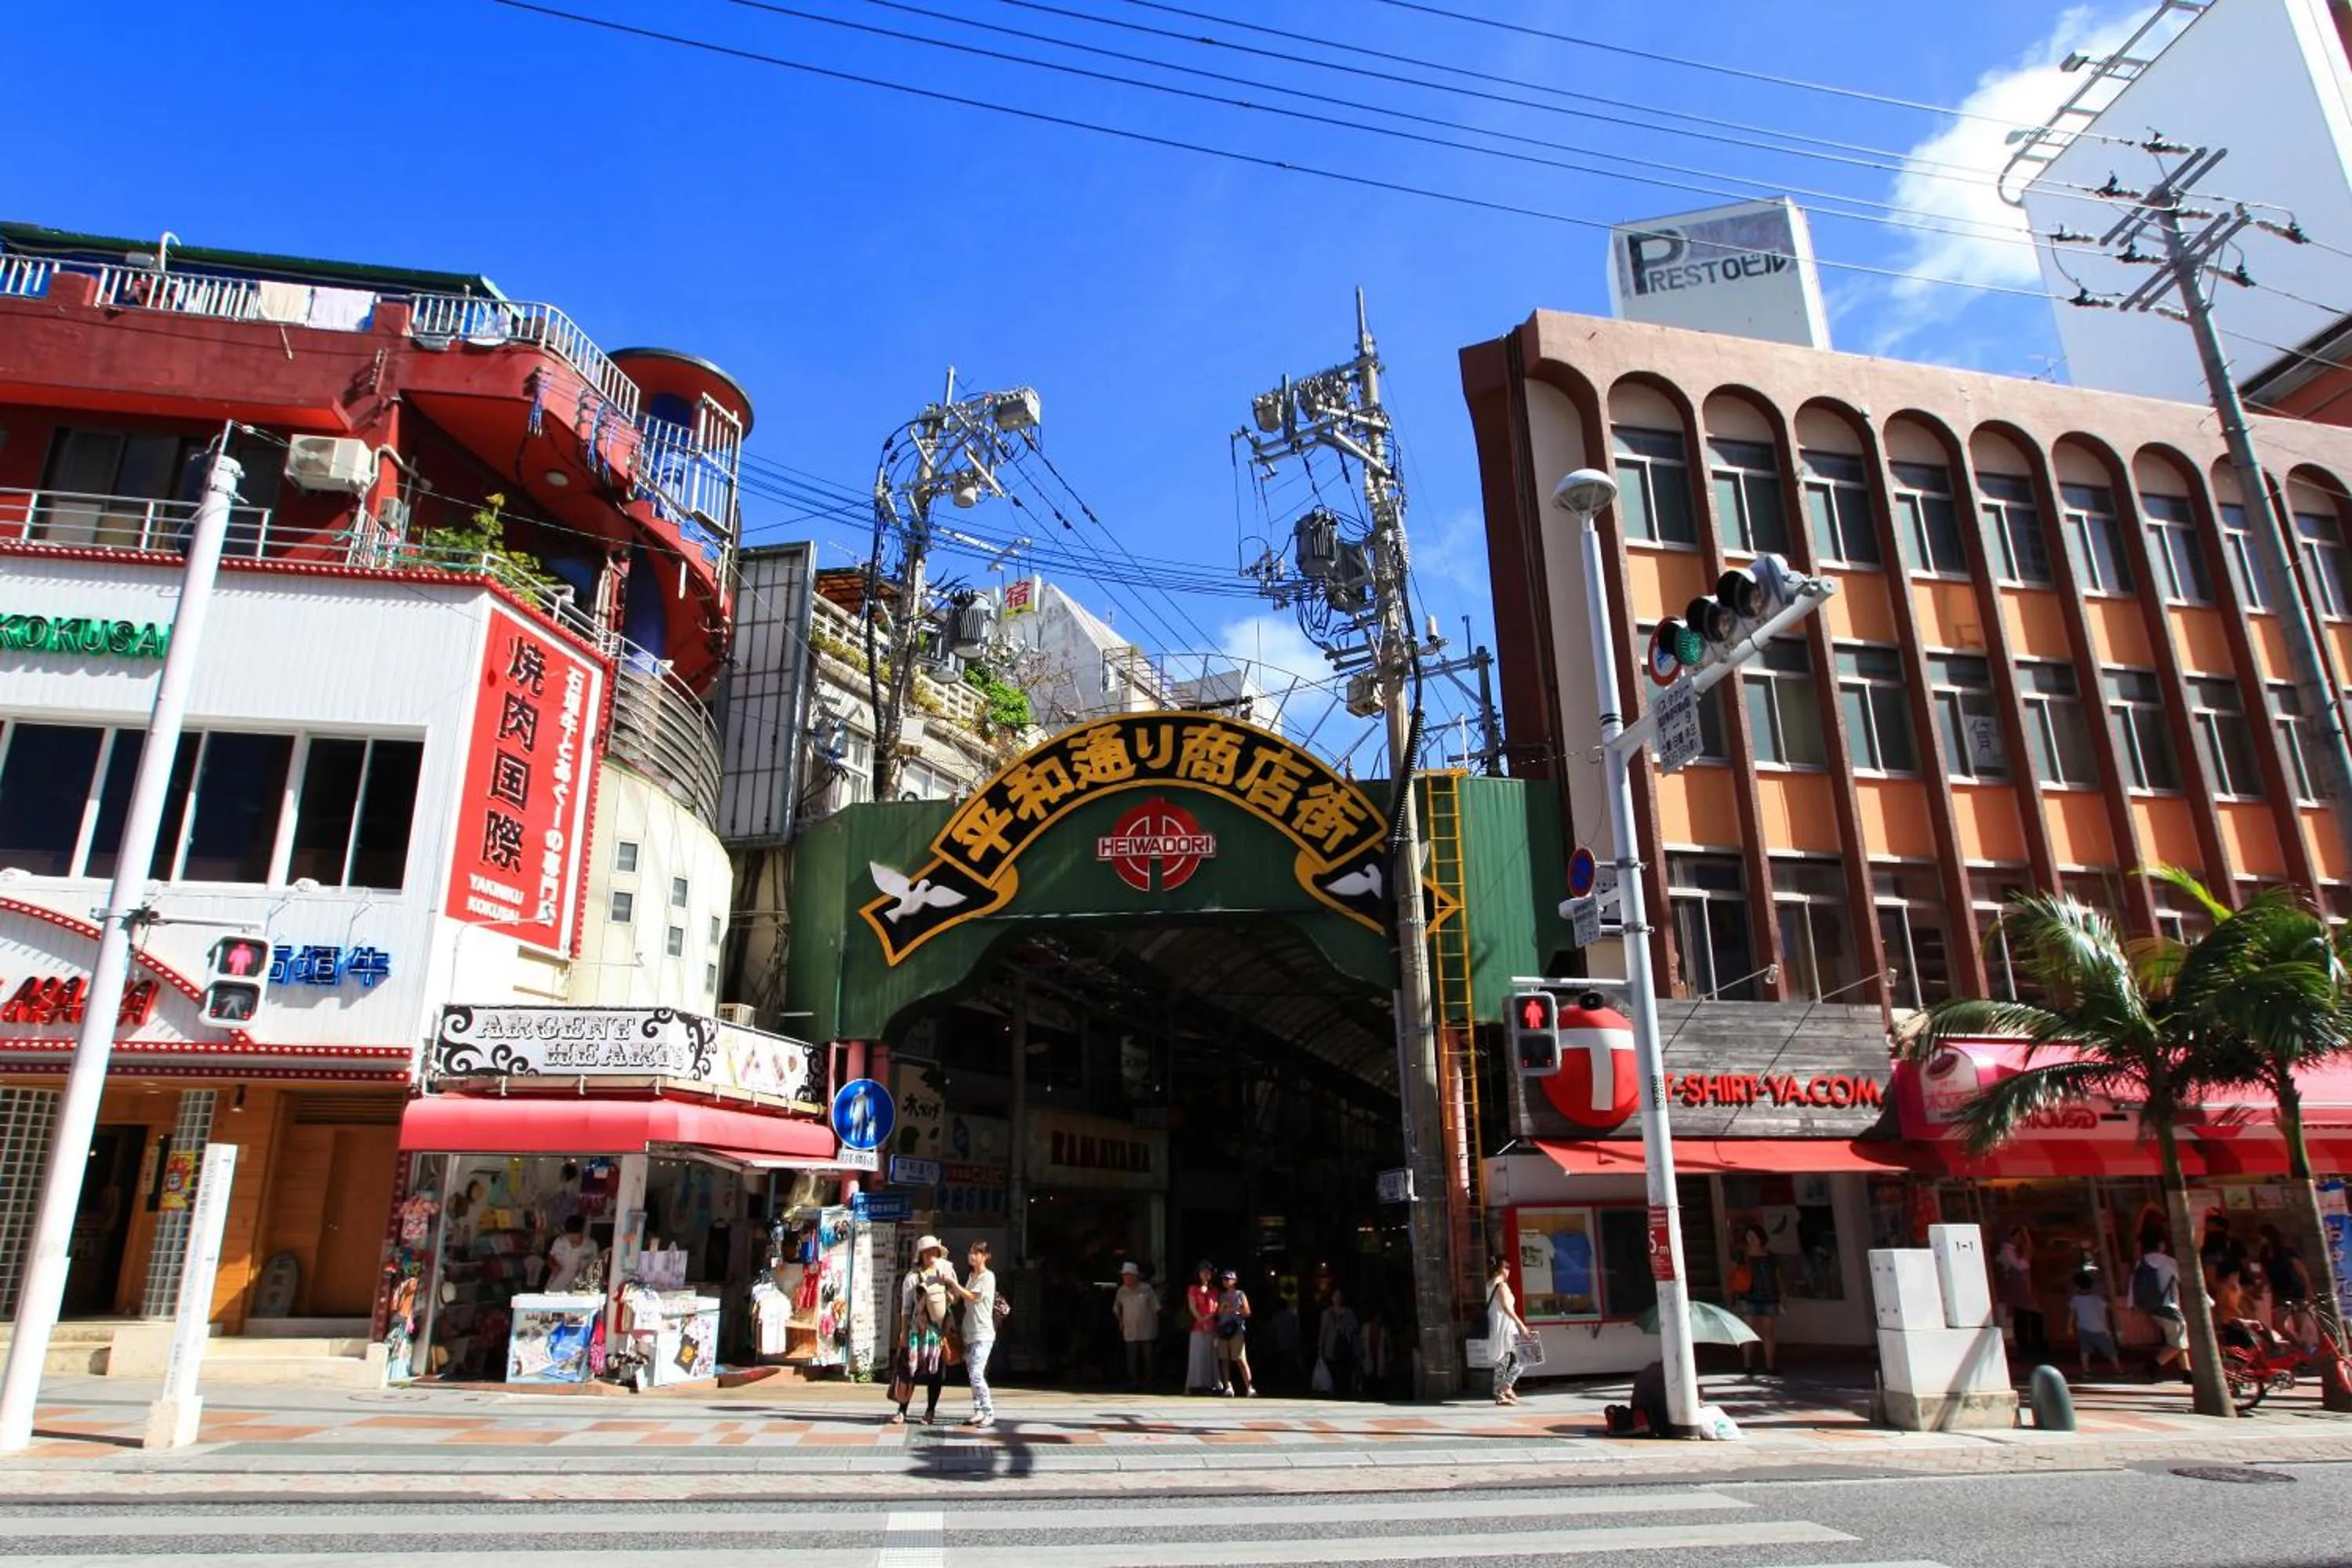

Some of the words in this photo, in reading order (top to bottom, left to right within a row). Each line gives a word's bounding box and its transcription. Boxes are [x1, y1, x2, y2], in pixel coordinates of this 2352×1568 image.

[479, 636, 546, 873] 焼肉国際
[951, 720, 1367, 862] 平和通り商店街
[1099, 835, 1212, 857] HEIWADORI
[476, 1014, 636, 1040] ARGENT
[1664, 1073, 1882, 1107] T-SHIRT-YA.COM
[1649, 1230, 1657, 1254] 5
